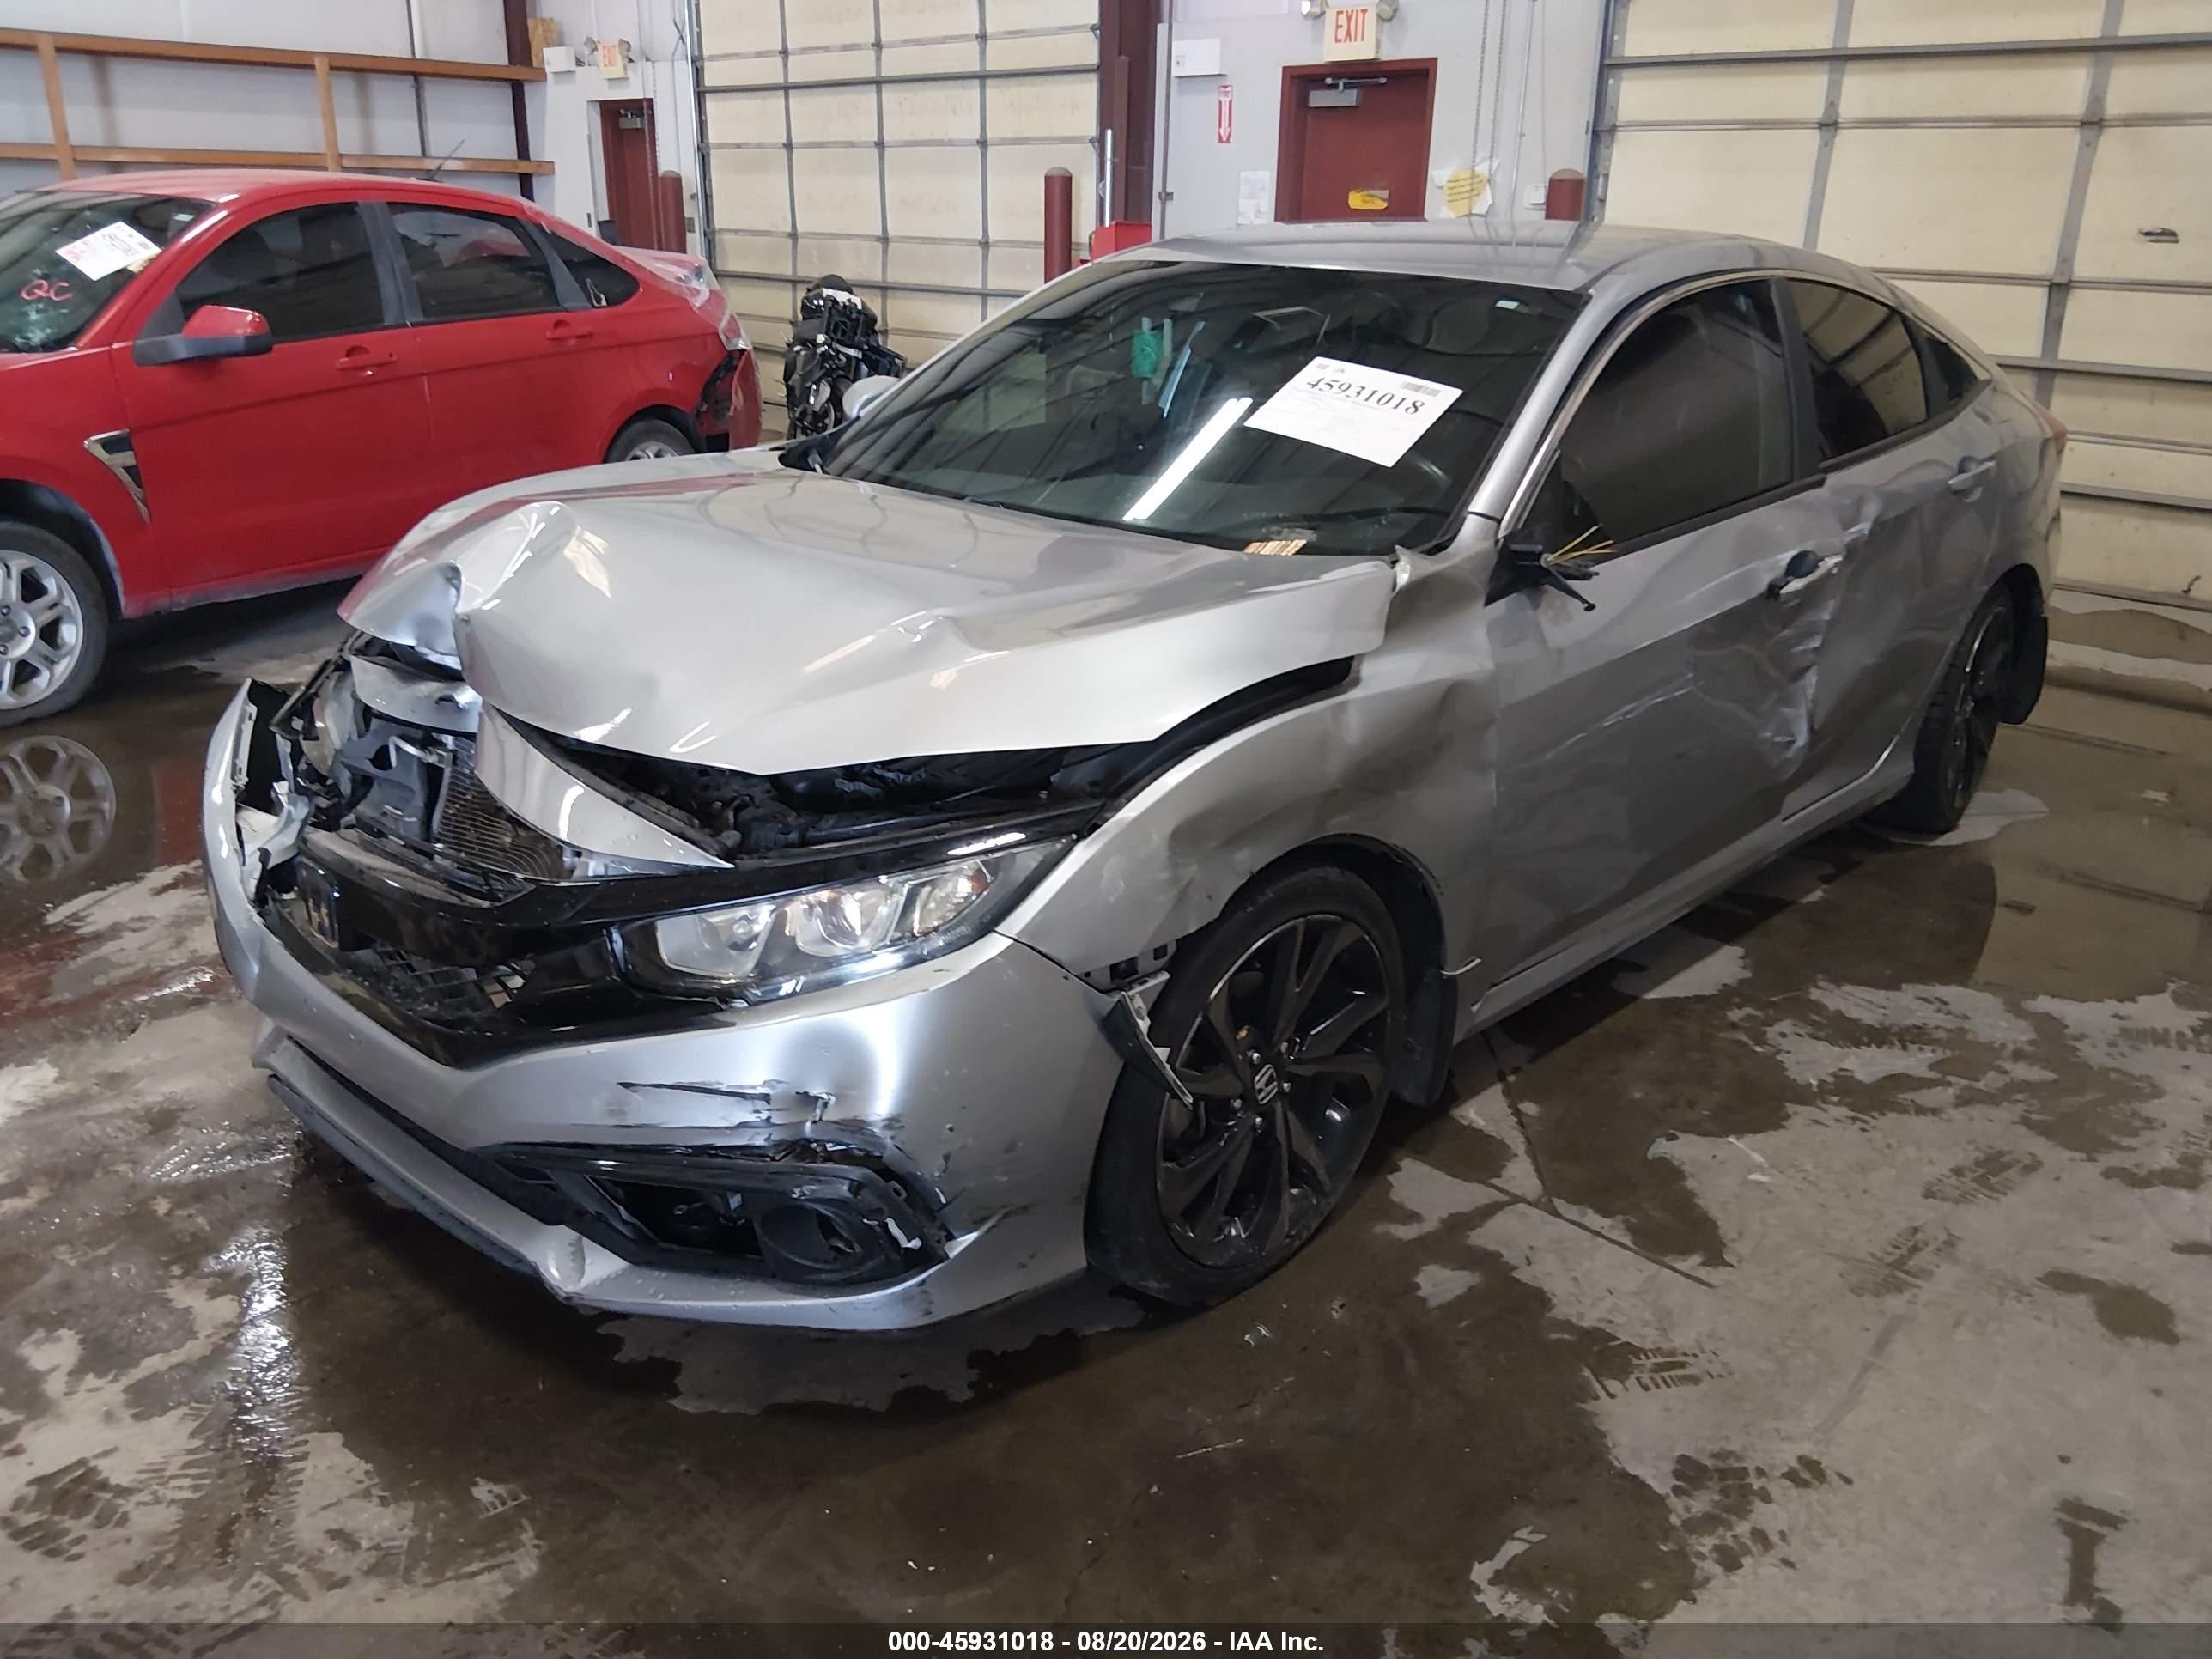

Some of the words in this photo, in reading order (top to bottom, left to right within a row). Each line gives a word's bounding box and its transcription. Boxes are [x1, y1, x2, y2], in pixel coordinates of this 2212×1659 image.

[1334, 8, 1369, 44] EXIT
[21, 278, 74, 301] QC
[1307, 377, 1426, 415] 45931018
